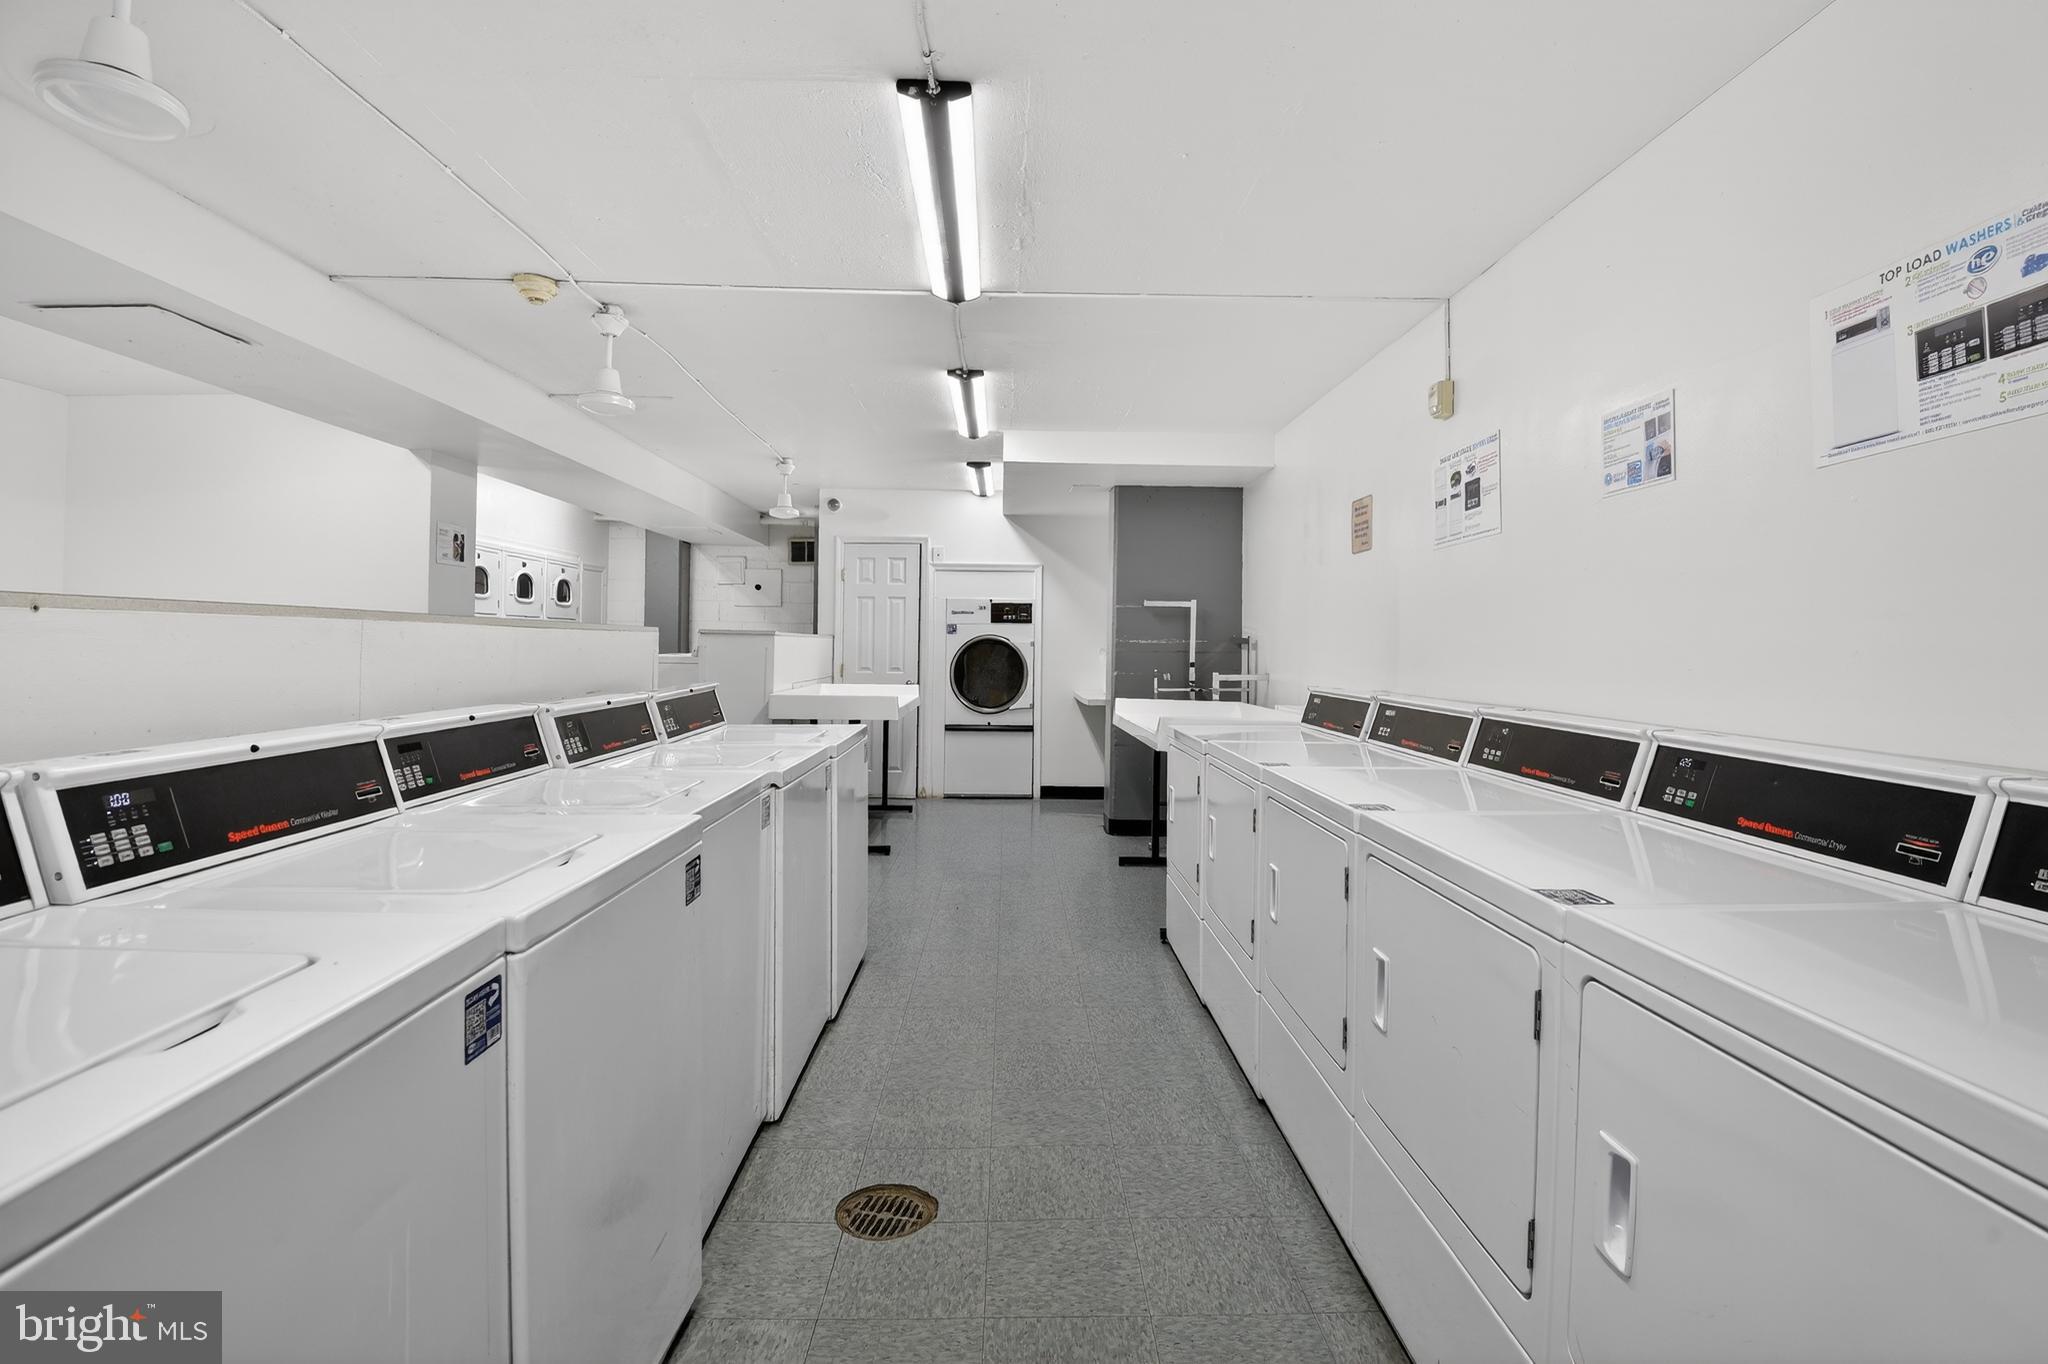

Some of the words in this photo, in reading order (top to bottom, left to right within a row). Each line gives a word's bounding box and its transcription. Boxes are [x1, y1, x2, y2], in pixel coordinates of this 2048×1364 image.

[1879, 266, 1902, 285] TOP
[1906, 249, 1942, 274] LOAD
[1945, 217, 2012, 256] WASHERS
[1905, 276, 1912, 288] 2
[1907, 325, 1914, 336] 3
[1998, 373, 2006, 384] 4
[2000, 391, 2007, 403] 5
[228, 825, 260, 842] Speed
[260, 819, 290, 834] Queen
[1737, 816, 1764, 831] Speed
[1764, 822, 1793, 839] Queen
